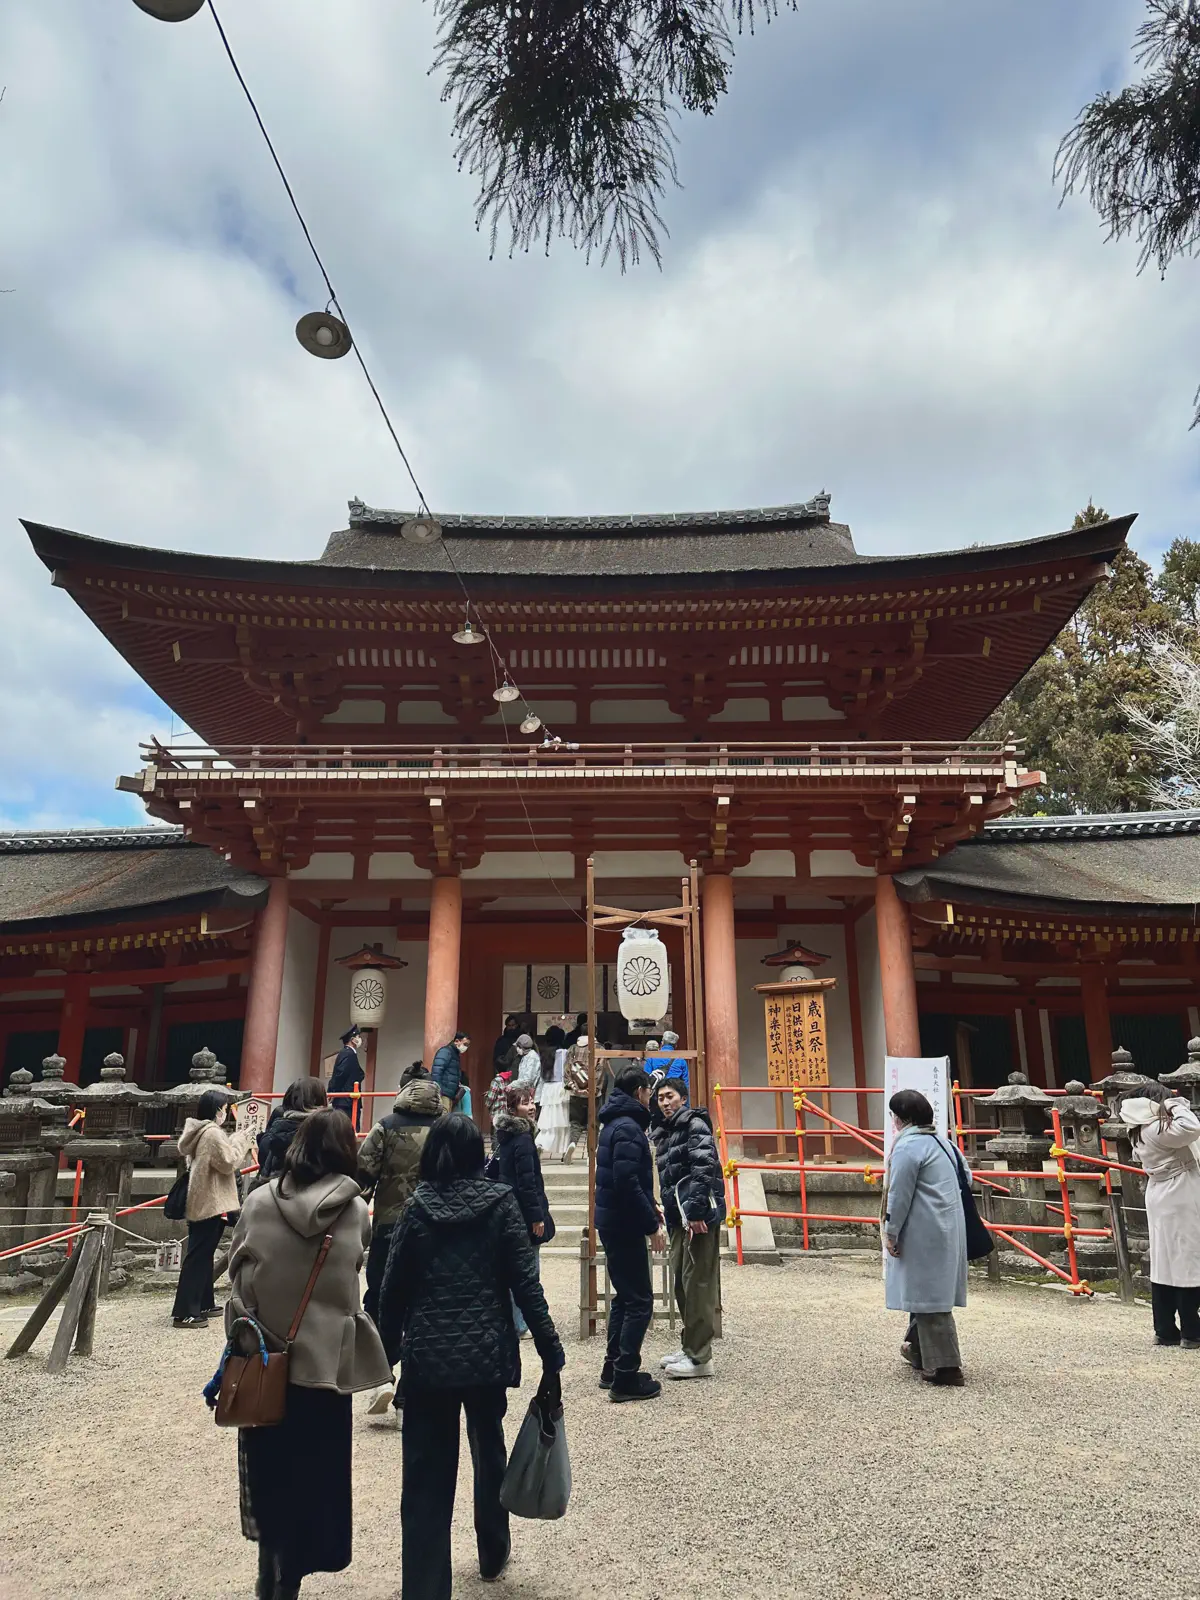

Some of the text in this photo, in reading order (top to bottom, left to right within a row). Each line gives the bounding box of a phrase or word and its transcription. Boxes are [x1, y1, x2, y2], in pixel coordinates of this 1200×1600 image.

[768, 1003, 782, 1055] 神楽始式
[792, 1002, 804, 1051] 日供始式
[808, 1000, 823, 1053] 歳旦祭
